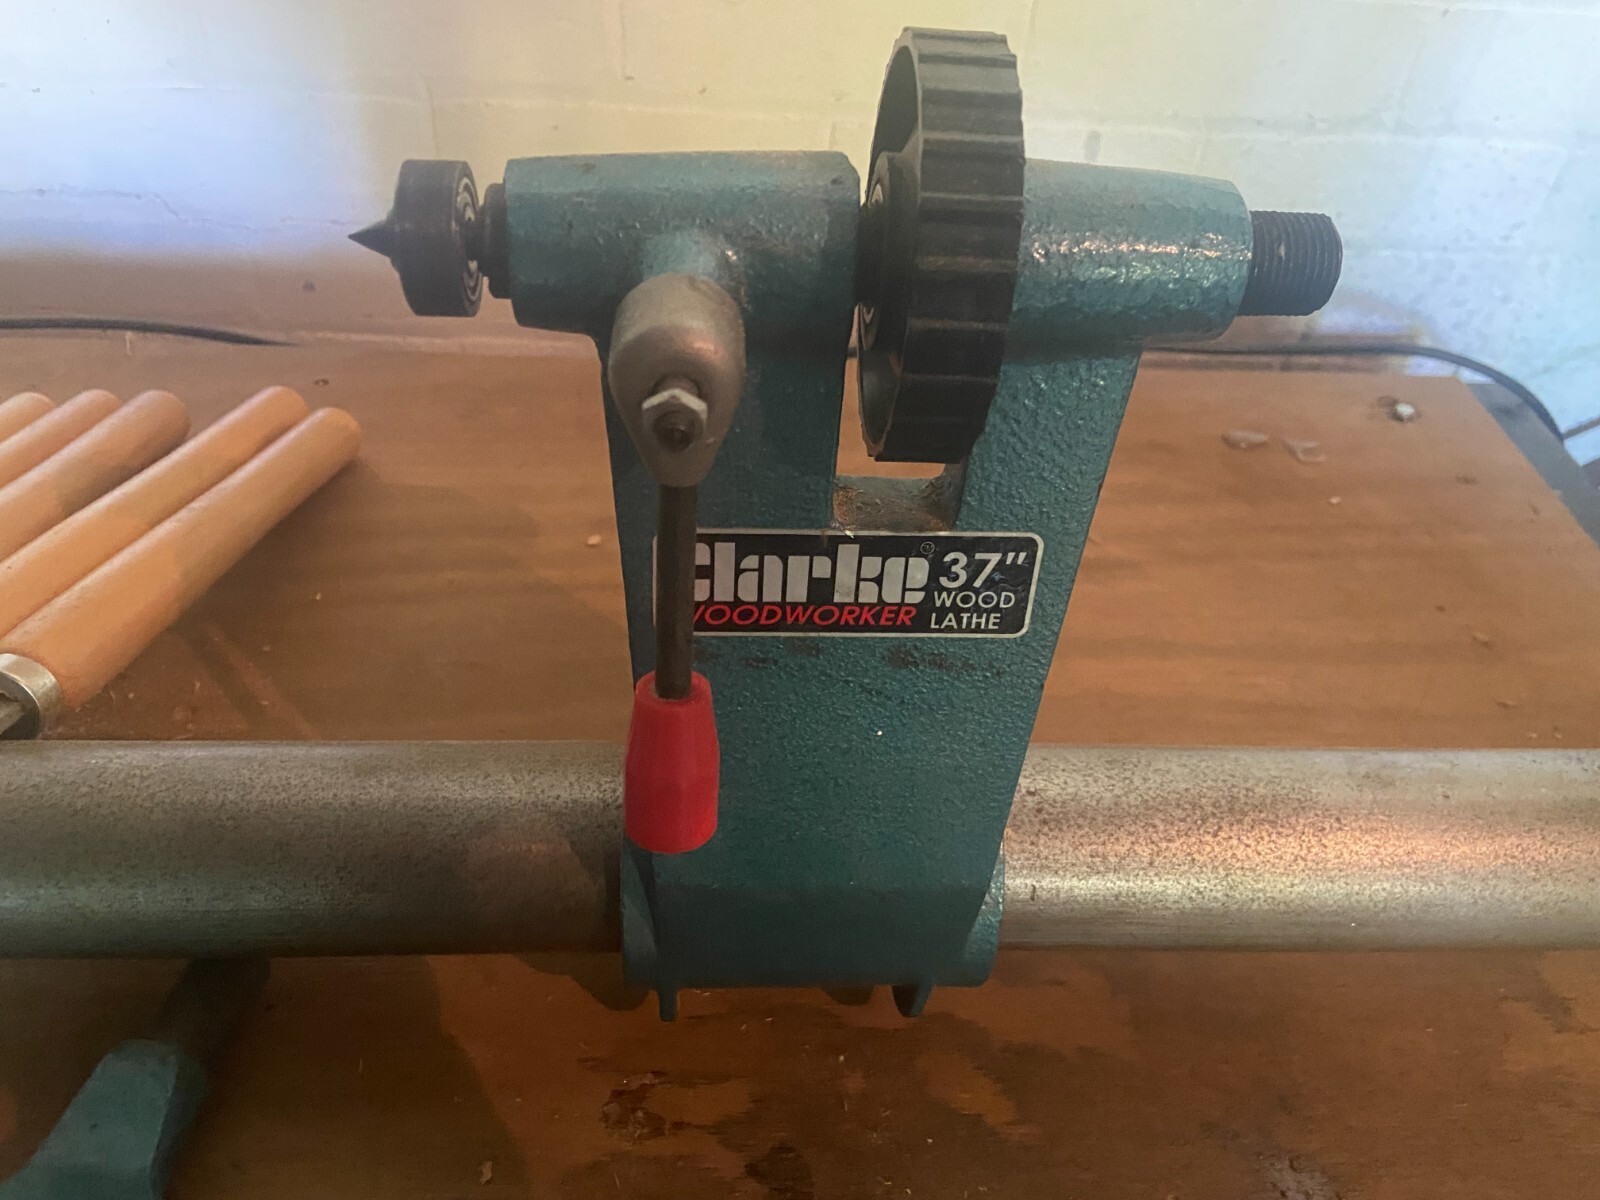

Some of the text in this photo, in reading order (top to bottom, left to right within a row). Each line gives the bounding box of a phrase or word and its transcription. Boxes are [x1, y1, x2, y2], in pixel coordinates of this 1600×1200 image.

[938, 550, 1028, 589] 37"
[933, 590, 1016, 609] WOOD
[693, 603, 917, 626] OODWORKER
[929, 611, 1001, 630] LATHE
